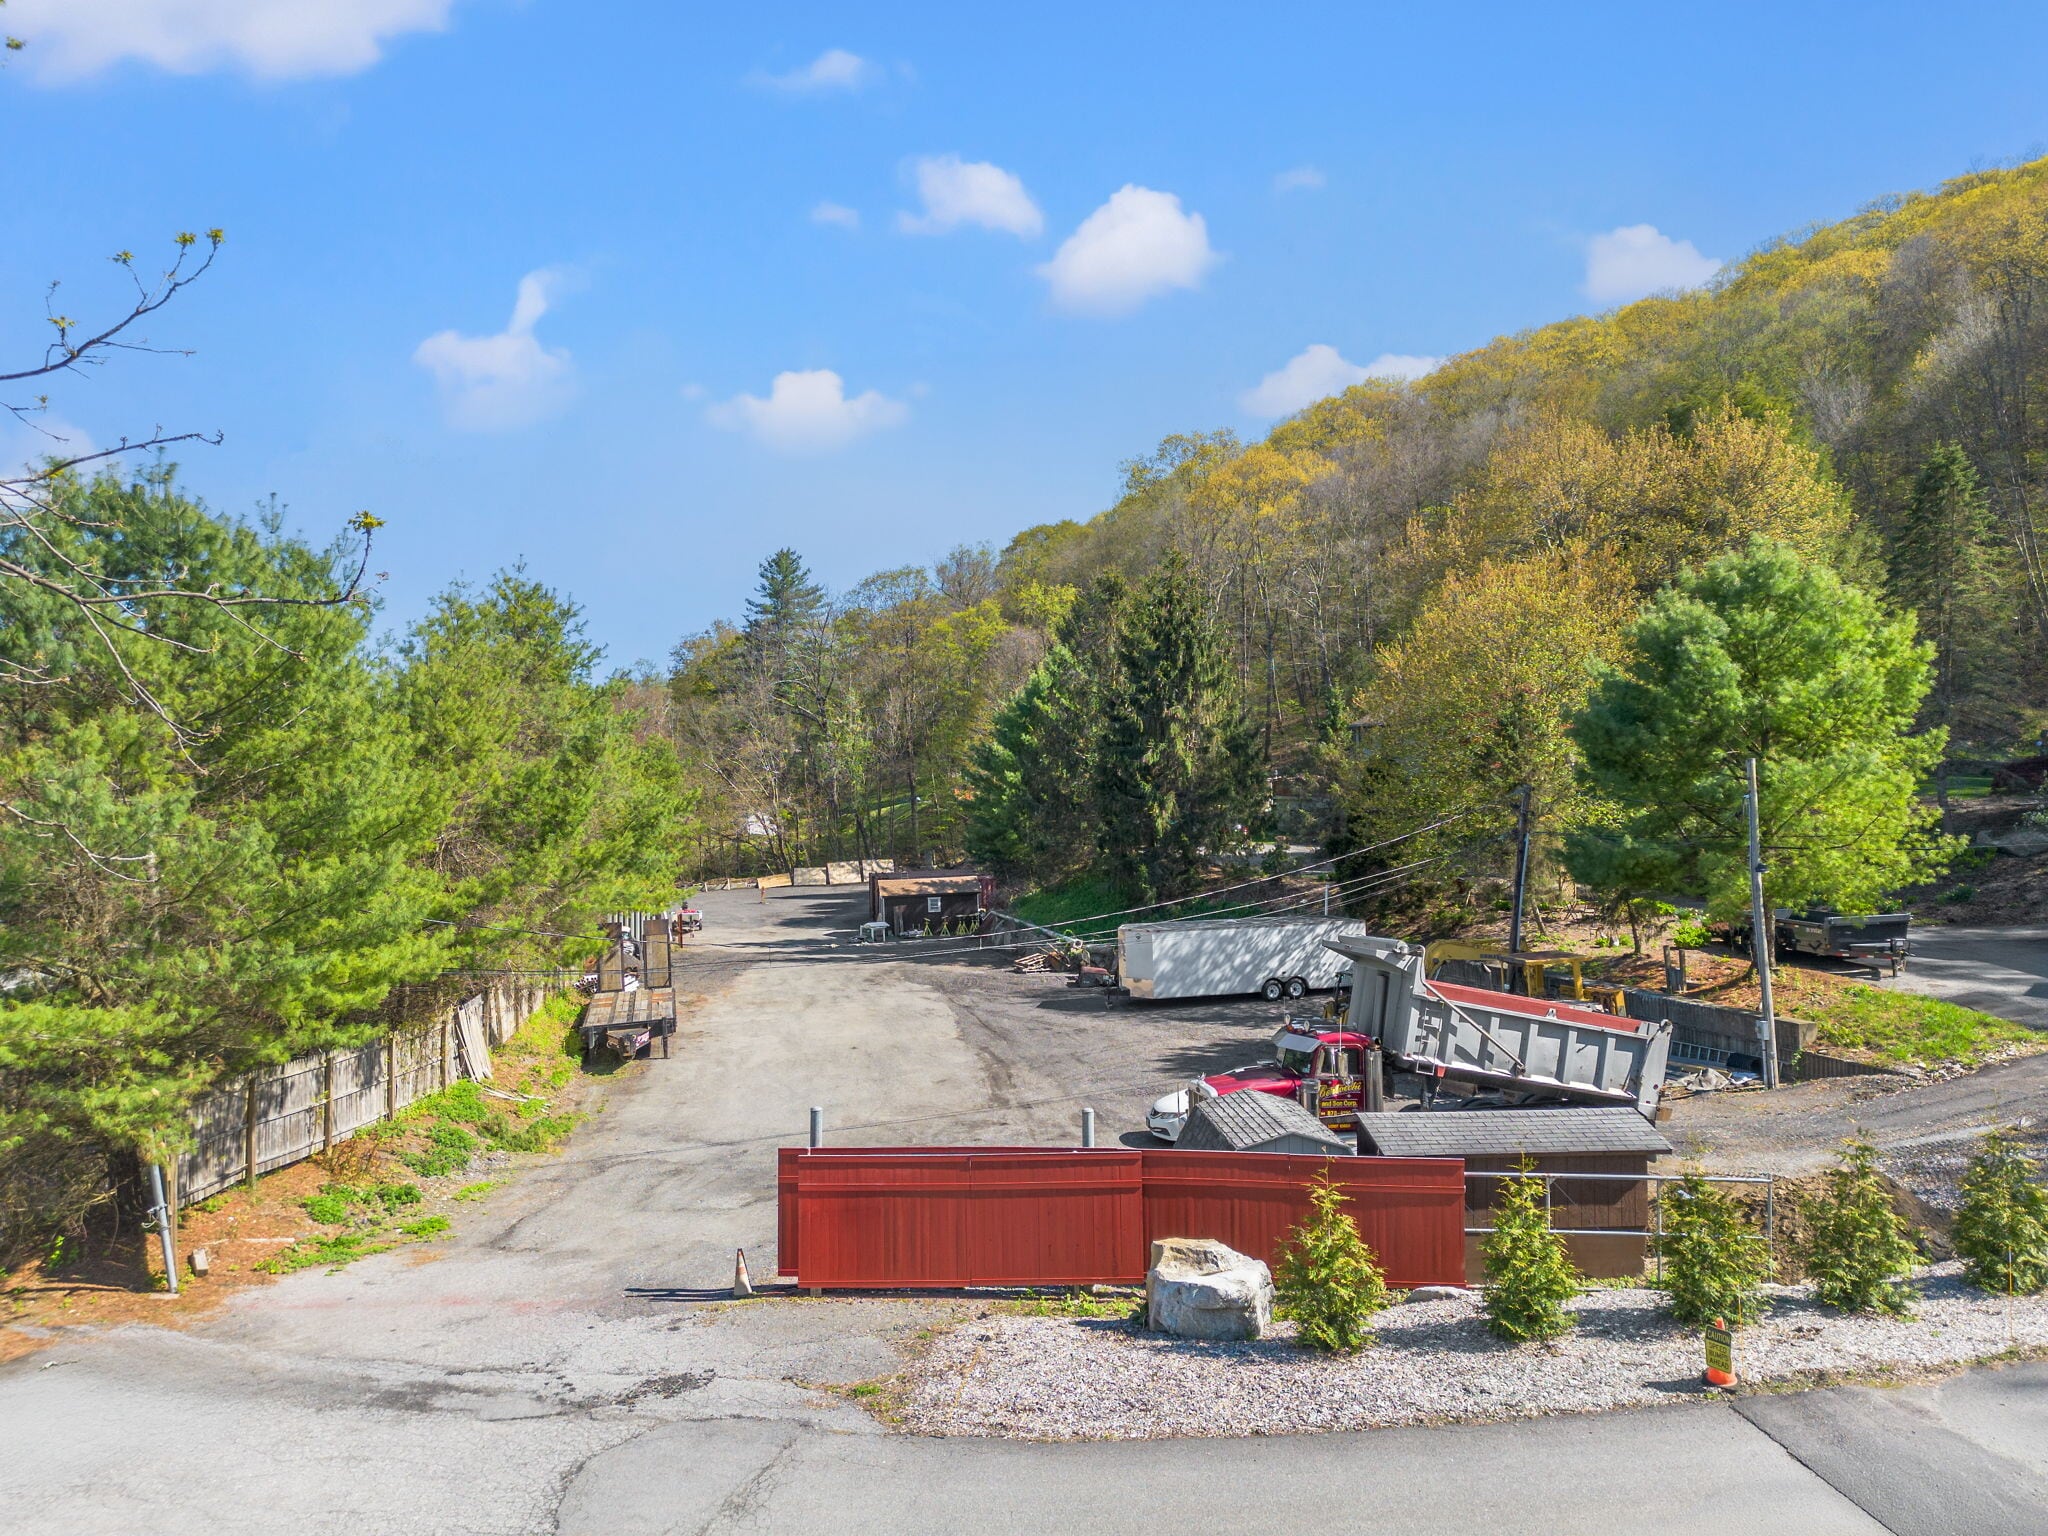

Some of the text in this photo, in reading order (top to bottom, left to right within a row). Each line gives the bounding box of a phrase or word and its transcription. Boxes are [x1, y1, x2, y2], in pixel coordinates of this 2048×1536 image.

[1708, 1329, 1730, 1344] CAUTION
[1709, 1341, 1727, 1353] SPEED
[1709, 1358, 1728, 1369] AHEAD
